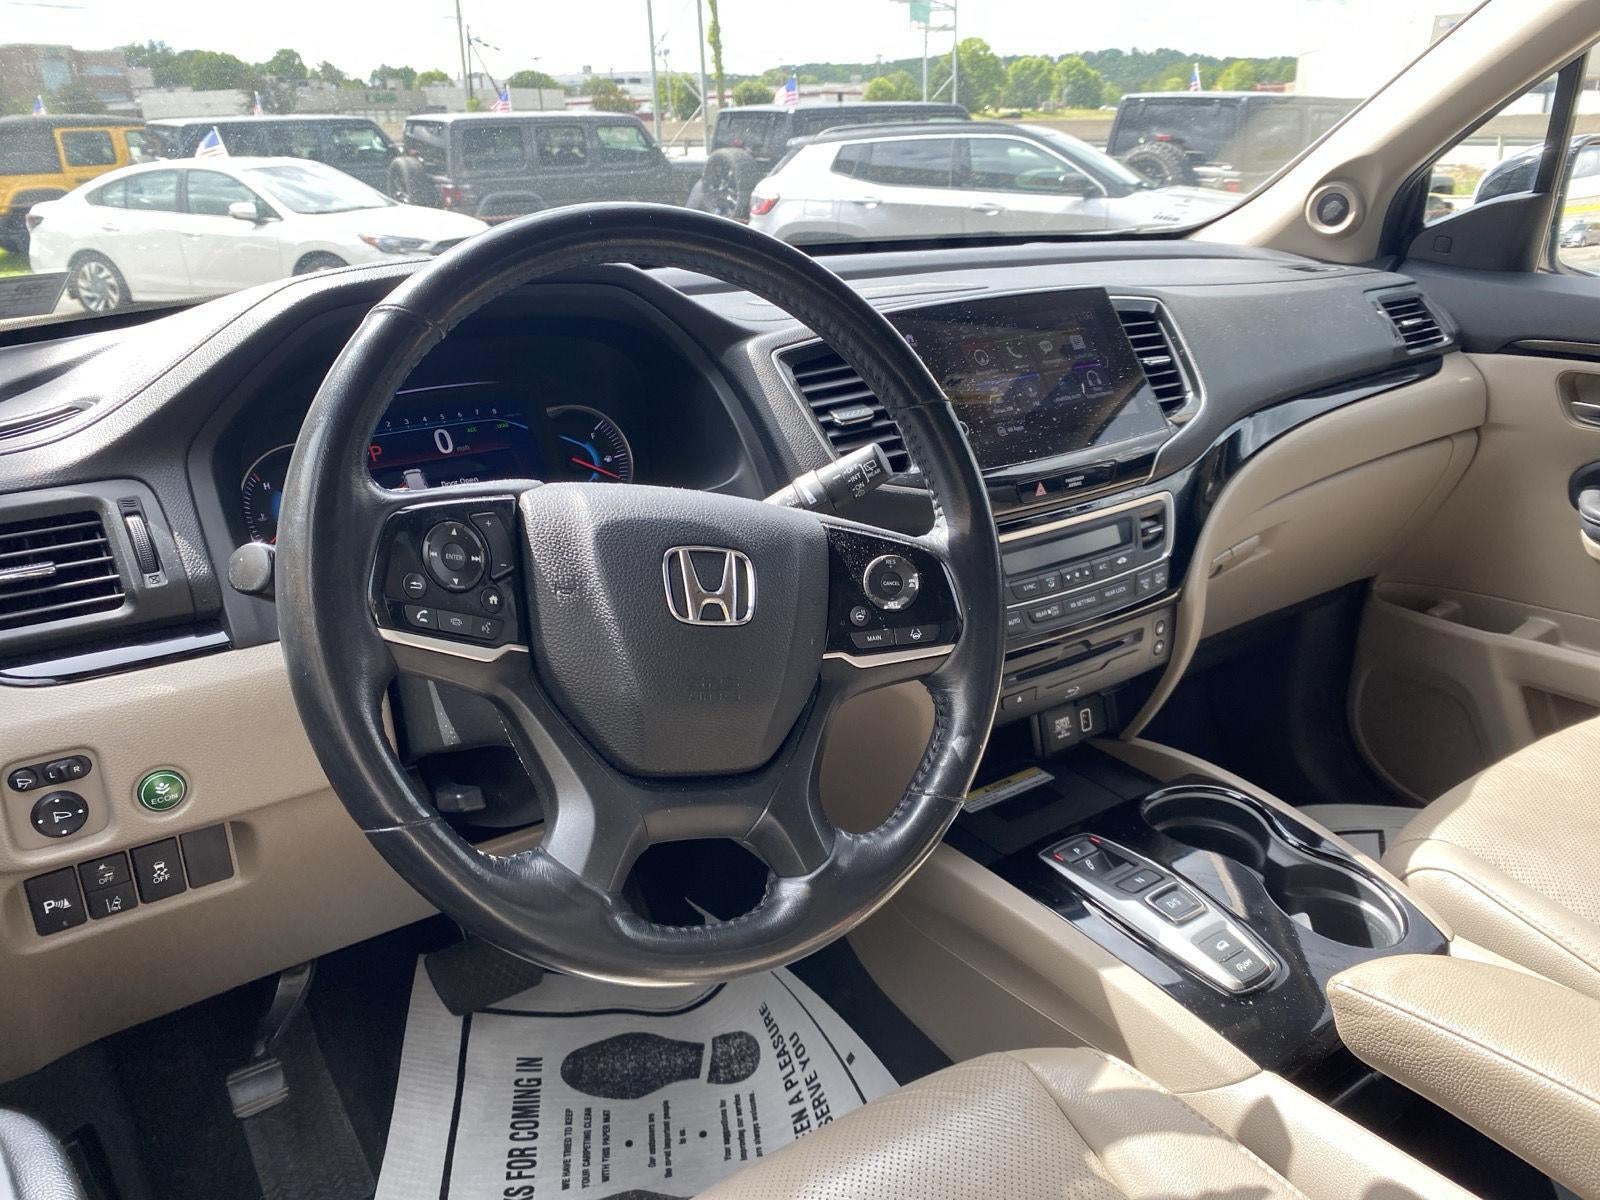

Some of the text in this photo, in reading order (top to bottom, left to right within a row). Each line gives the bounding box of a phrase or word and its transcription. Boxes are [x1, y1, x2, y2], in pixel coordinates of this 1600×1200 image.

[369, 445, 382, 462] P
[434, 429, 454, 454] 0
[460, 477, 479, 486] Open
[850, 473, 861, 483] INT
[263, 482, 271, 490] H
[855, 482, 864, 491] ON
[446, 552, 463, 561] ENTER
[1024, 583, 1036, 591] SYNC
[1115, 586, 1126, 594] LOCK
[1008, 618, 1020, 626] AUTO
[151, 792, 178, 805] ECON
[98, 875, 114, 885] OFF
[152, 873, 170, 884] OFF
[43, 900, 54, 914] P
[789, 1032, 810, 1072] YOU
[516, 1057, 543, 1072] IN
[759, 1001, 812, 1140] EN A PLEASURE
[509, 1078, 542, 1142] COMING
[662, 1100, 671, 1119] people
[734, 1094, 742, 1116] service
[602, 1124, 610, 1145] PAPER
[753, 1122, 761, 1144] always
[562, 1108, 573, 1190] WE HAVE TRIED TO KEEP
[582, 1107, 592, 1189] YOUR CARPETING CLEAN
[602, 1147, 610, 1162] THIS
[506, 1146, 537, 1180] FOR
[648, 1156, 656, 1168] Our
[602, 1163, 610, 1183] WITH
[664, 1167, 672, 1178] the
